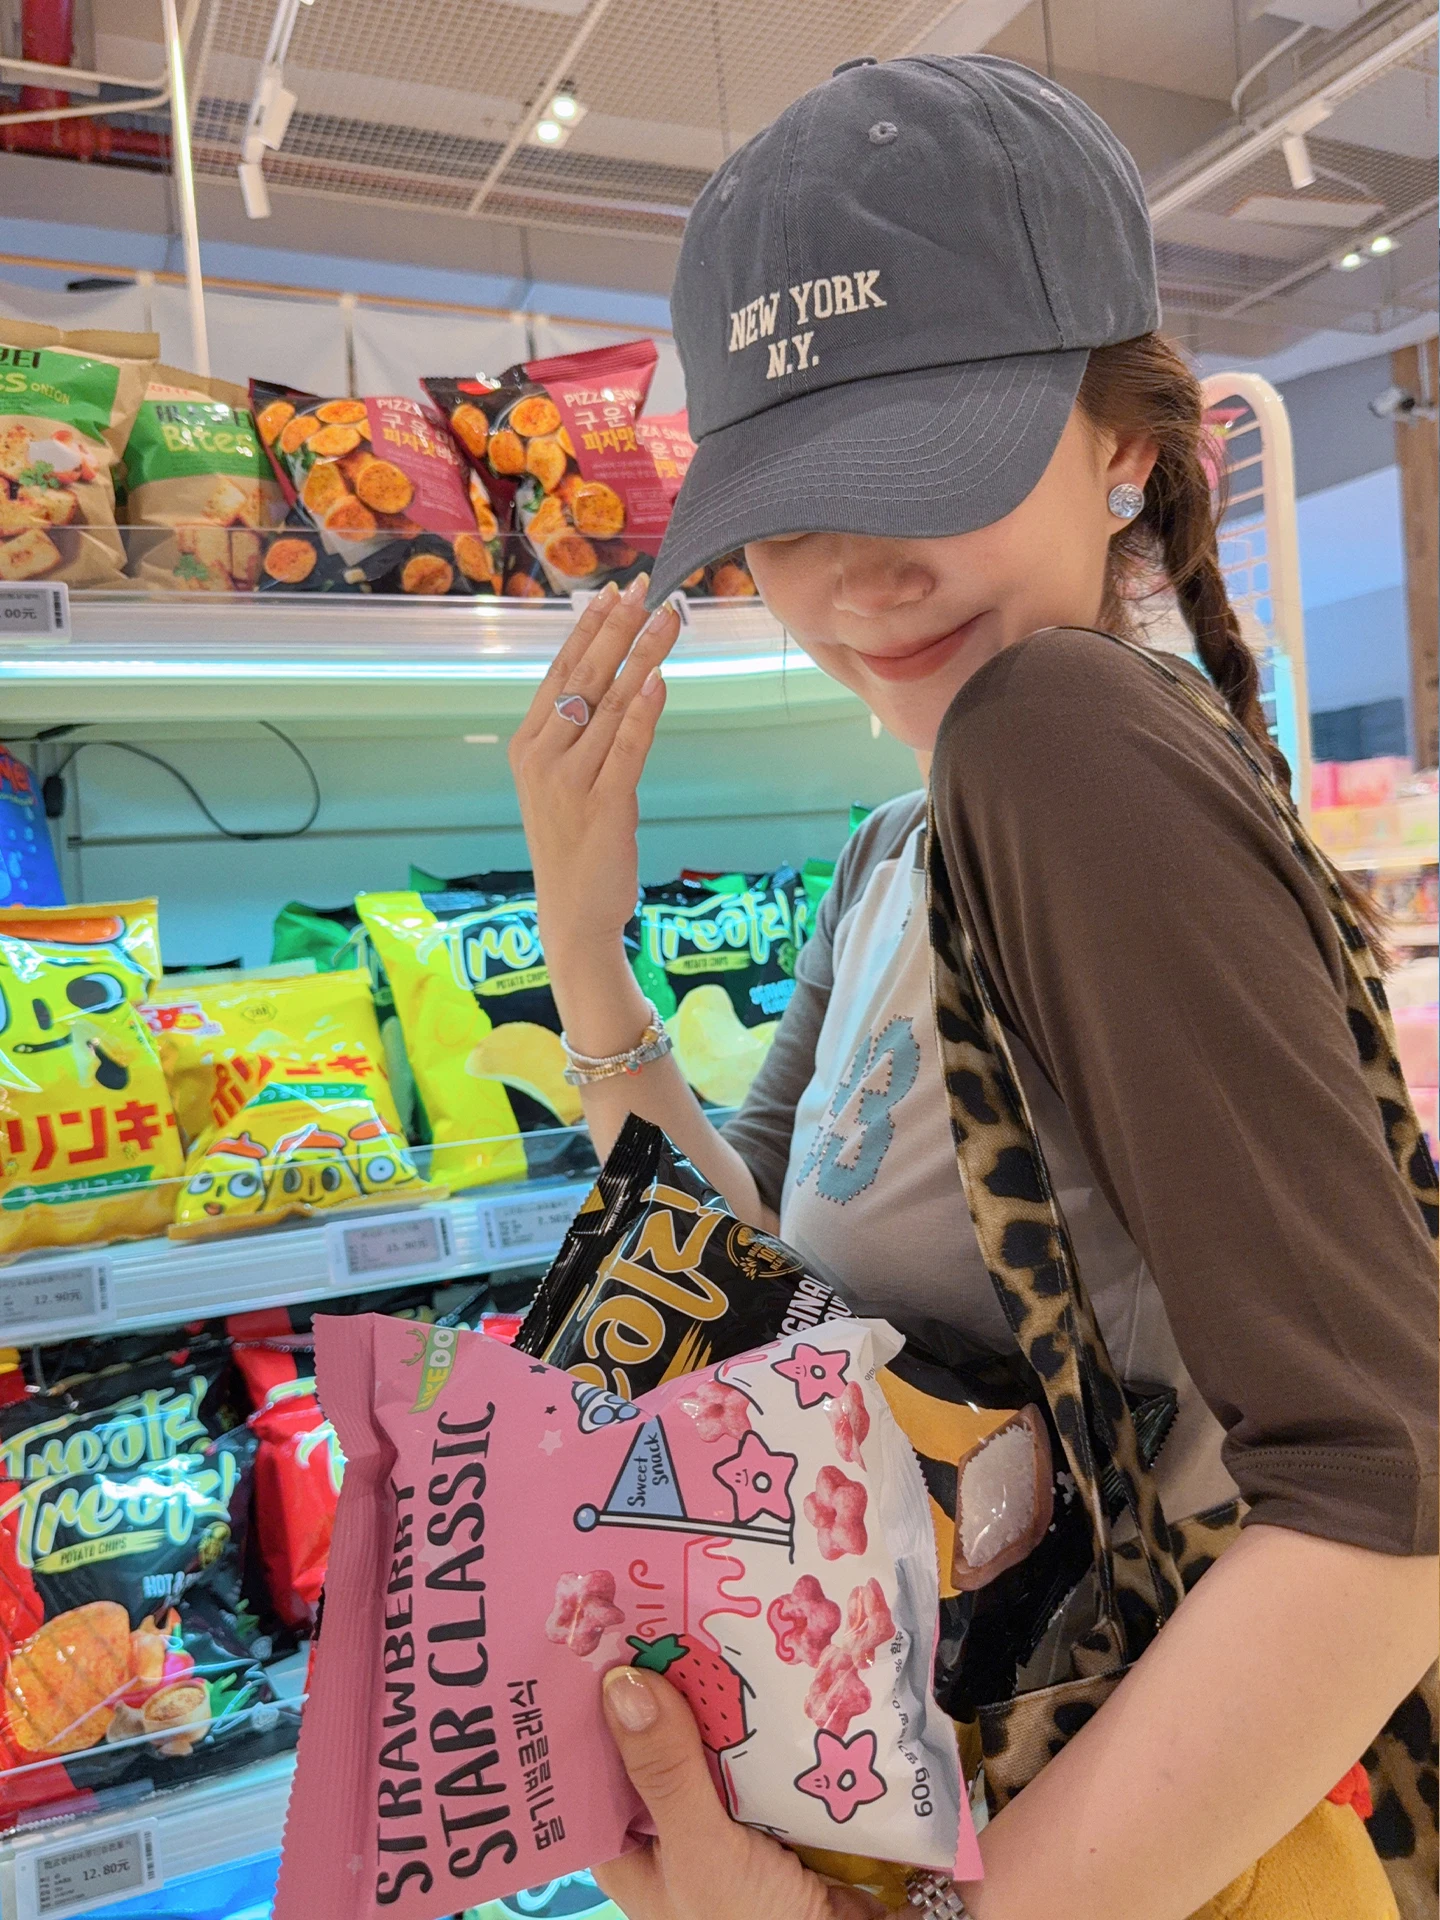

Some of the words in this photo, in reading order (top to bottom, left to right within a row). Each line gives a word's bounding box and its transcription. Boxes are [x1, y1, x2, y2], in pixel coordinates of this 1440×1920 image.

[728, 291, 780, 352] NEW
[789, 270, 887, 325] YORK
[766, 331, 819, 380] N.Y.
[626, 1455, 647, 1507] Sweet
[649, 1431, 670, 1487] snack
[425, 1400, 497, 1687] CLASSIC
[429, 1705, 518, 1880] STAR
[911, 1769, 933, 1818] 60g
[82, 1859, 130, 1882] 12.80元
